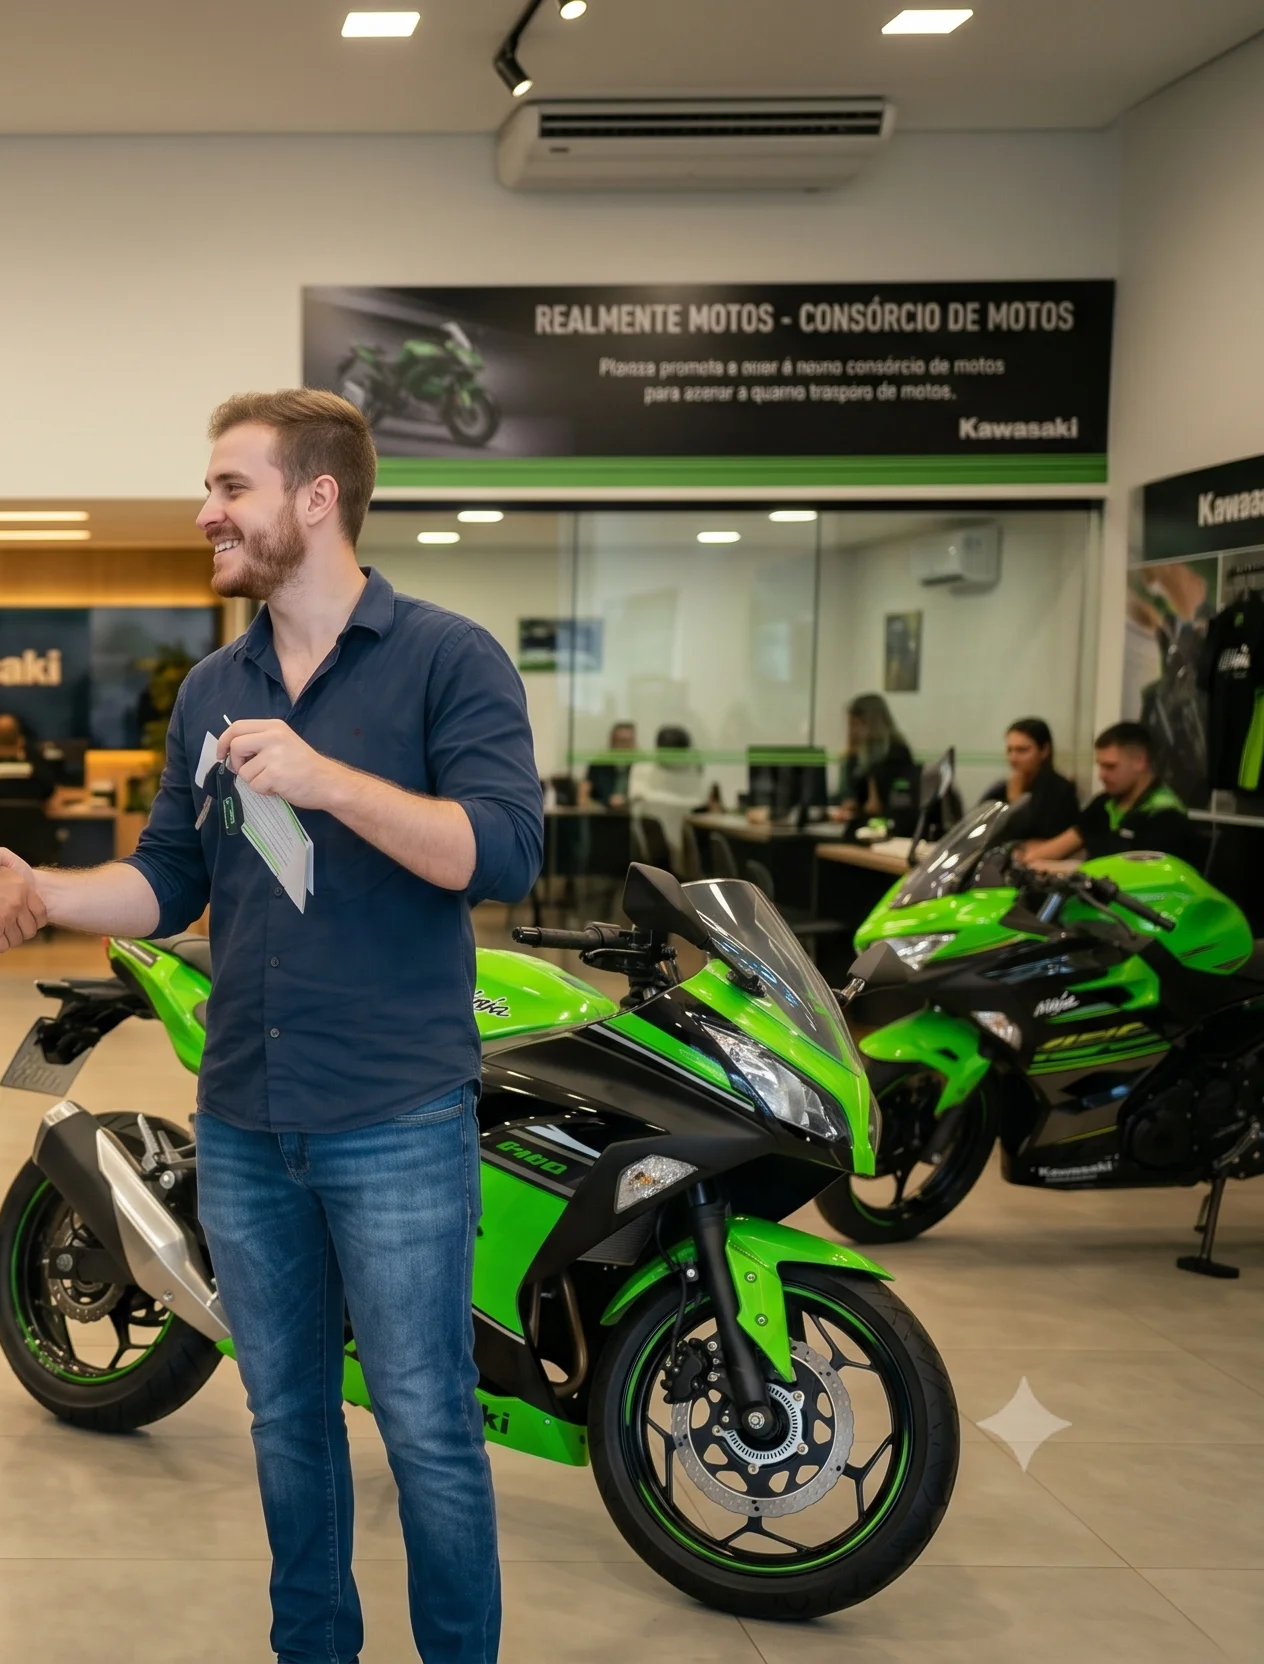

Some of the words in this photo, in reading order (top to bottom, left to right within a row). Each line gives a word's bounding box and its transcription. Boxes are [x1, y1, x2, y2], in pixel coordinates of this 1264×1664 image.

[535, 304, 683, 335] REALMENTE
[688, 303, 775, 334] MOTOS
[799, 296, 941, 333] CONSÓRCIO
[947, 303, 981, 332] DE
[987, 302, 1075, 332] MOTOS
[929, 355, 949, 375] de
[954, 357, 1005, 375] motos
[876, 380, 898, 401] de
[958, 416, 1079, 439] Kawasaki
